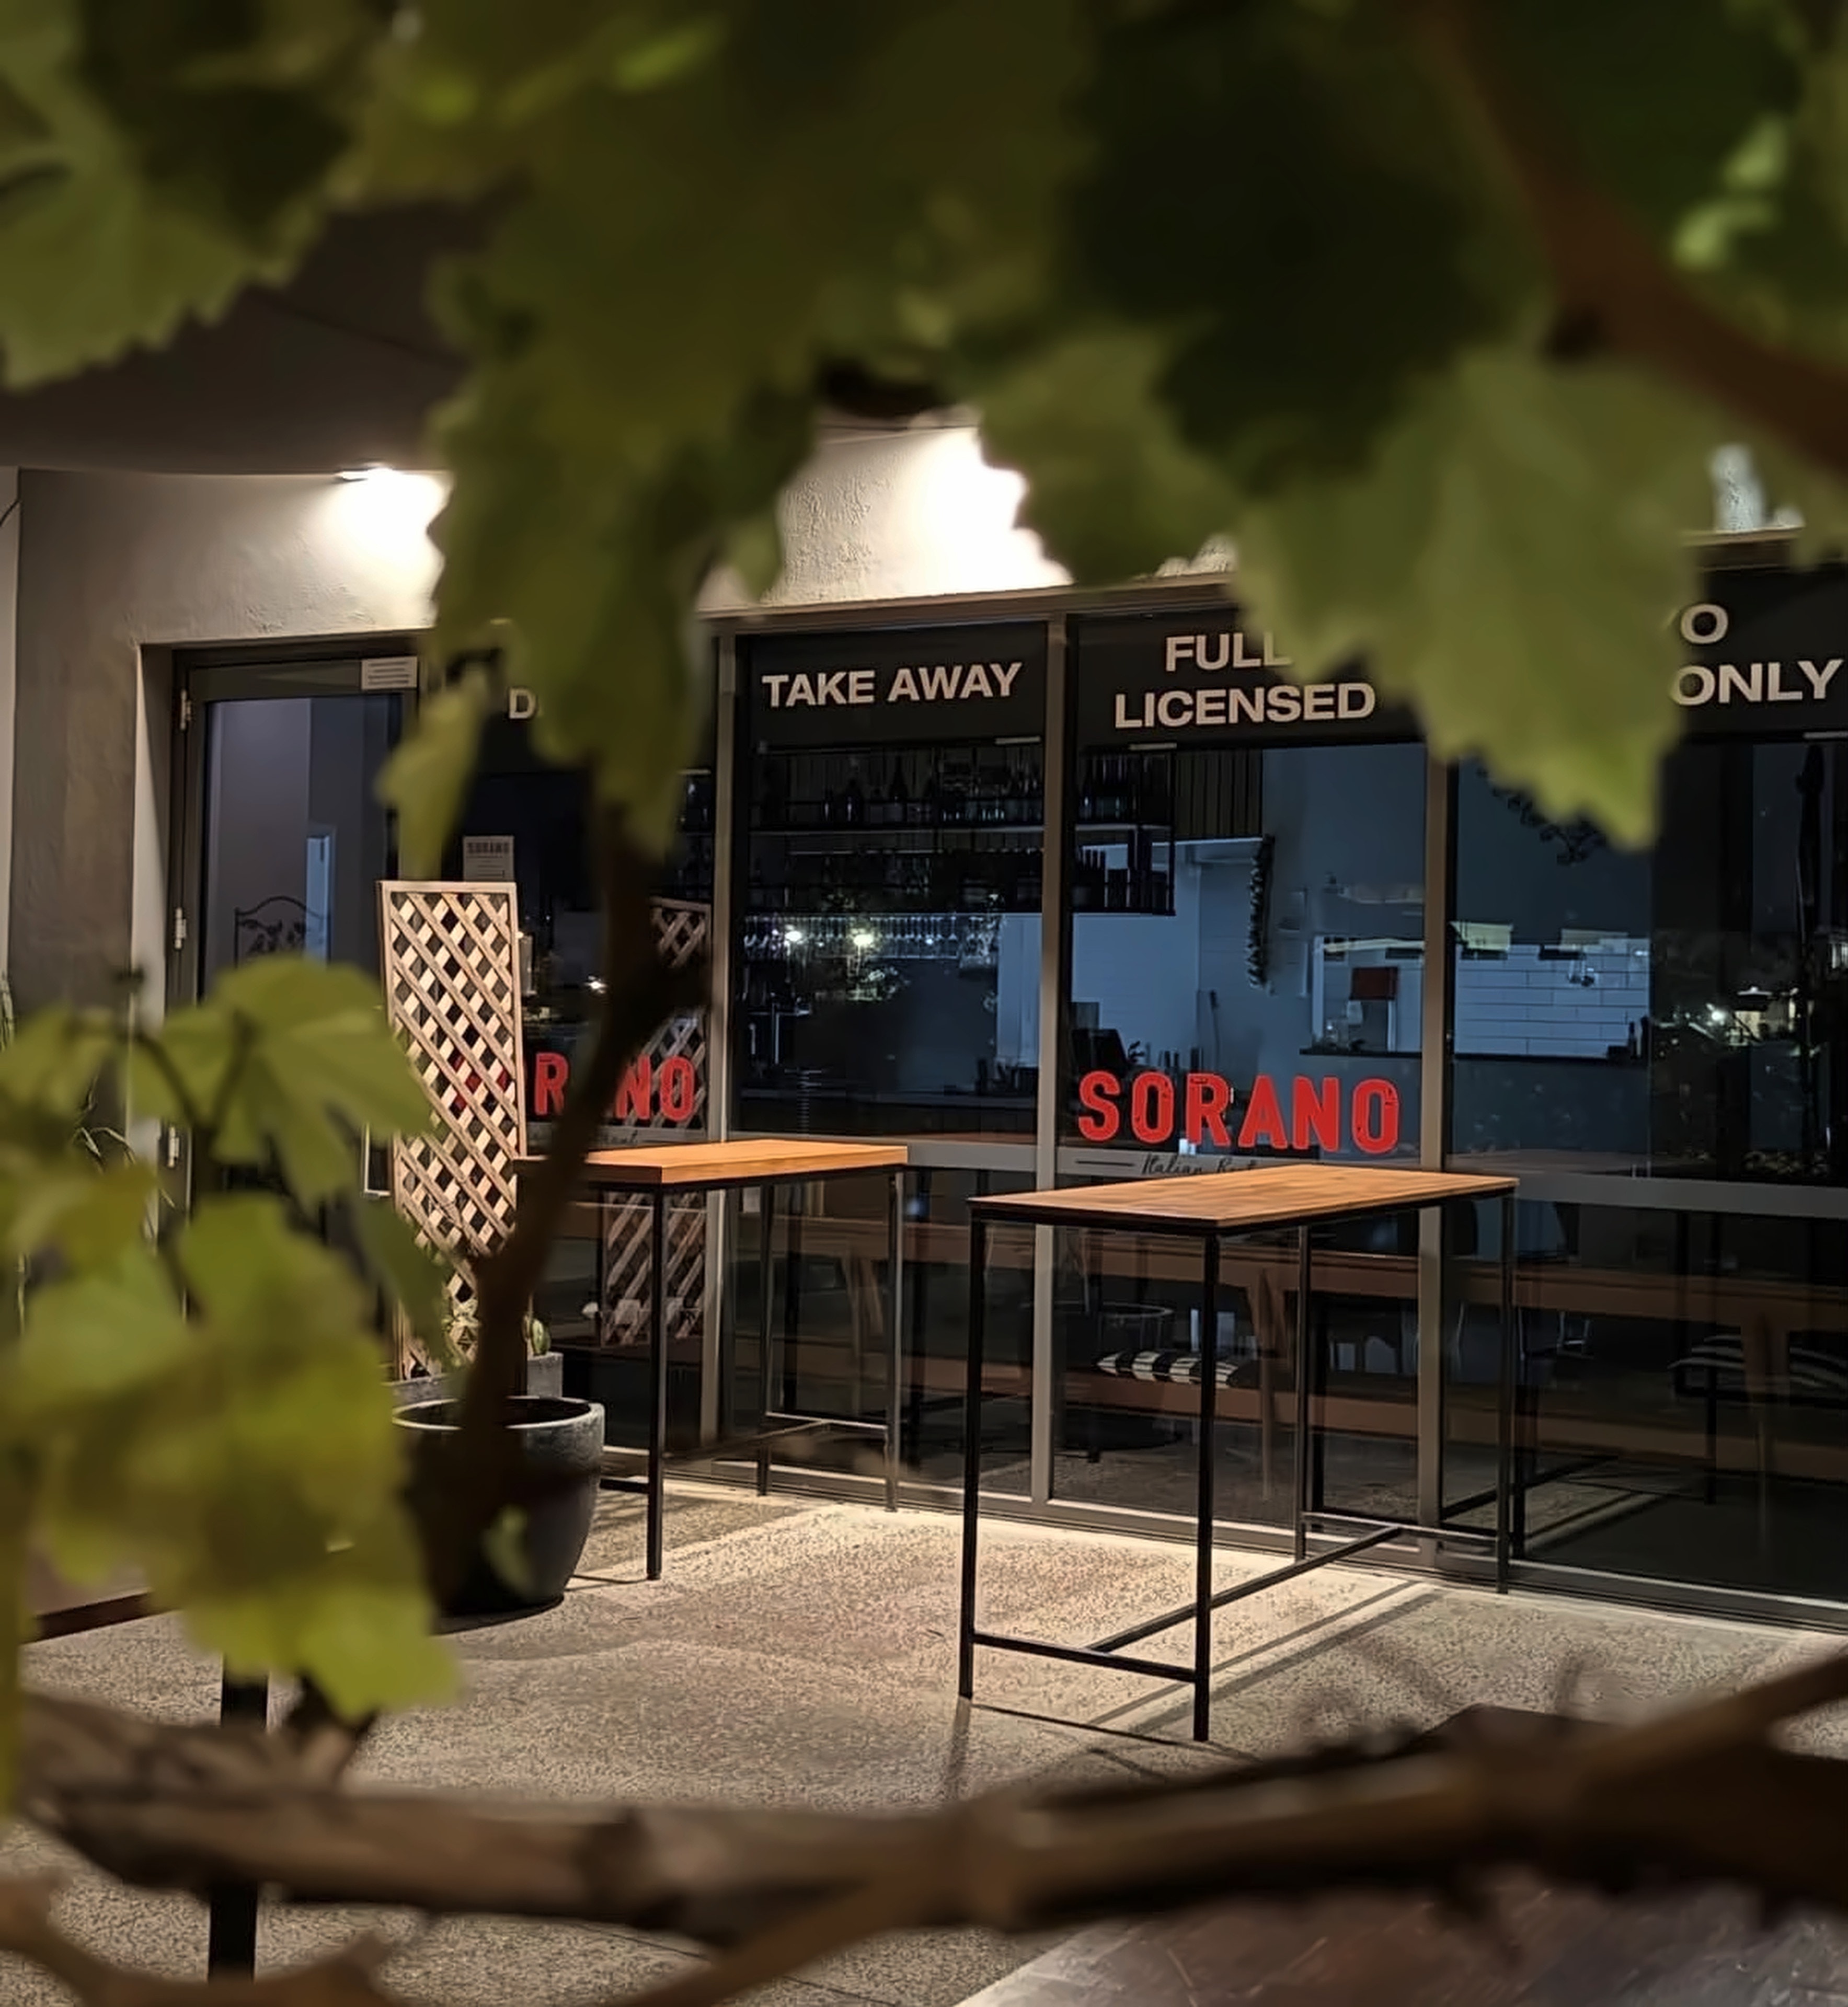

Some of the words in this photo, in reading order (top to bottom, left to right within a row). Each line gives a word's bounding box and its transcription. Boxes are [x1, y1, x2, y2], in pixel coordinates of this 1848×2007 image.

[1165, 632, 1293, 672] FULL
[762, 670, 875, 707] TAKE
[887, 662, 1023, 702] AWAY
[1115, 682, 1375, 729] LICENSED
[1669, 659, 1843, 706] ONLY
[1078, 1070, 1399, 1154] SORANO
